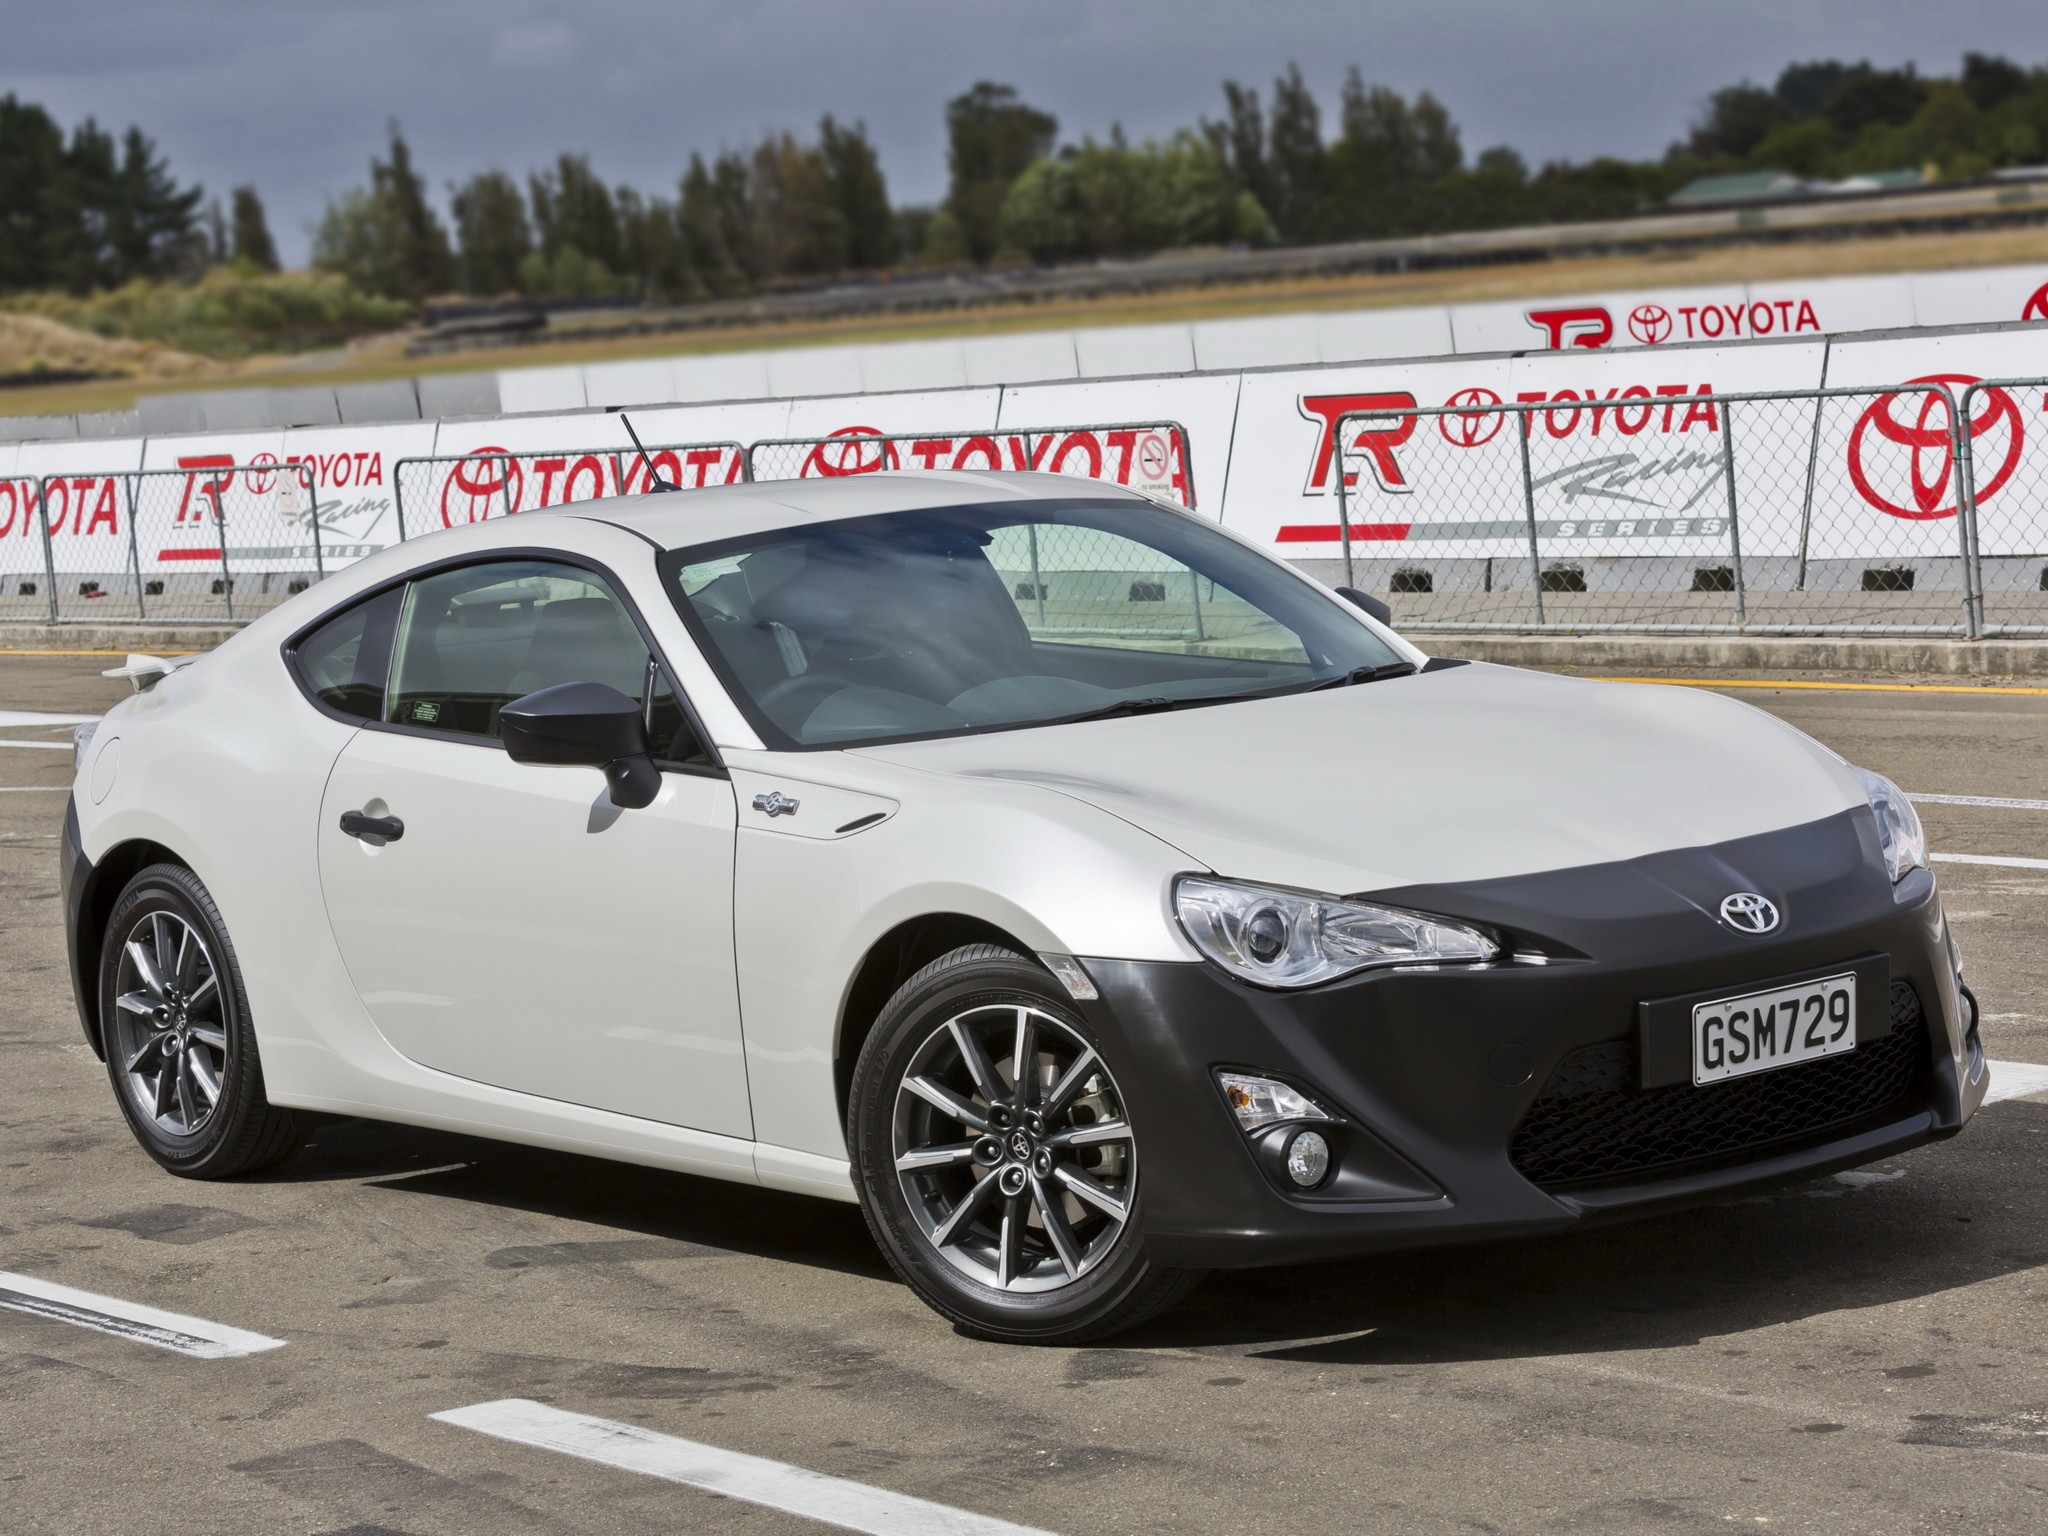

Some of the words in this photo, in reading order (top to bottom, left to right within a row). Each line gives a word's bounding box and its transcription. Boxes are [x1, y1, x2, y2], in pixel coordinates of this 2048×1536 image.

[1678, 299, 1821, 338] TOYOTA
[1516, 384, 1719, 440] TOYOTA
[1149, 482, 1170, 491] smoking
[1529, 447, 1738, 512] Racing
[287, 496, 391, 541] Racing
[1557, 519, 1723, 538] SERIES
[291, 545, 371, 558] SERIES
[1702, 988, 1850, 1070] GSM729
